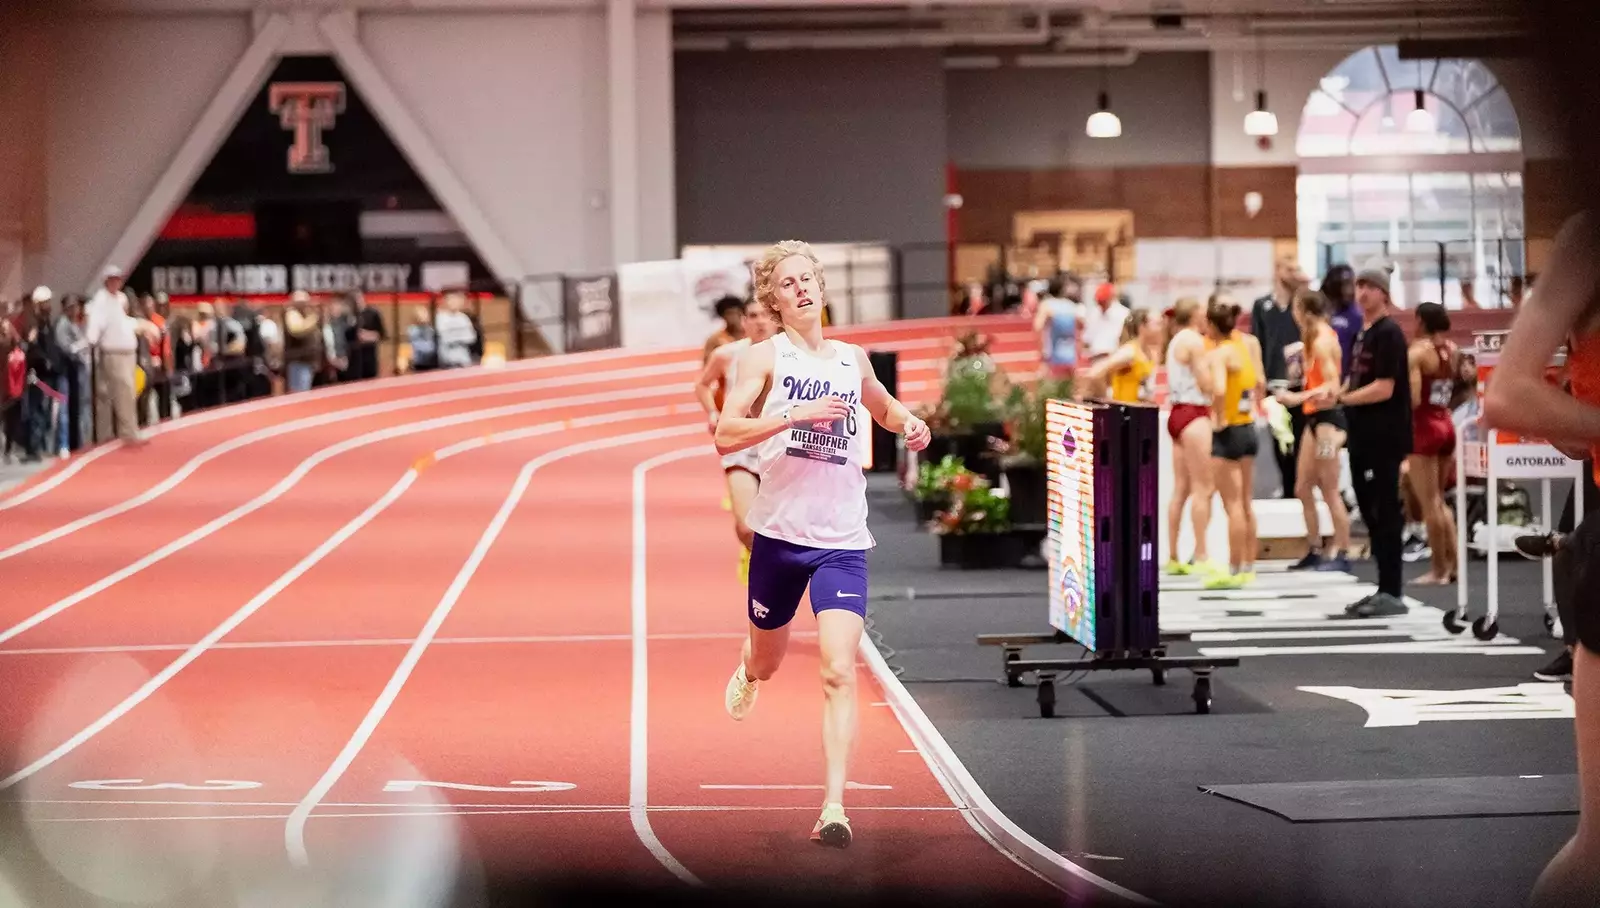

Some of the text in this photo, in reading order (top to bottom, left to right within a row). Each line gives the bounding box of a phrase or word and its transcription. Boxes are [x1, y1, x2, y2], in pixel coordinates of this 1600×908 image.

[151, 265, 198, 293] RED
[203, 264, 289, 294] RAIDER
[292, 263, 411, 293] RECOVERY
[791, 430, 848, 450] KIELHOFNER
[801, 443, 837, 455] KANSAS STATE
[1506, 456, 1567, 467] GATORADE
